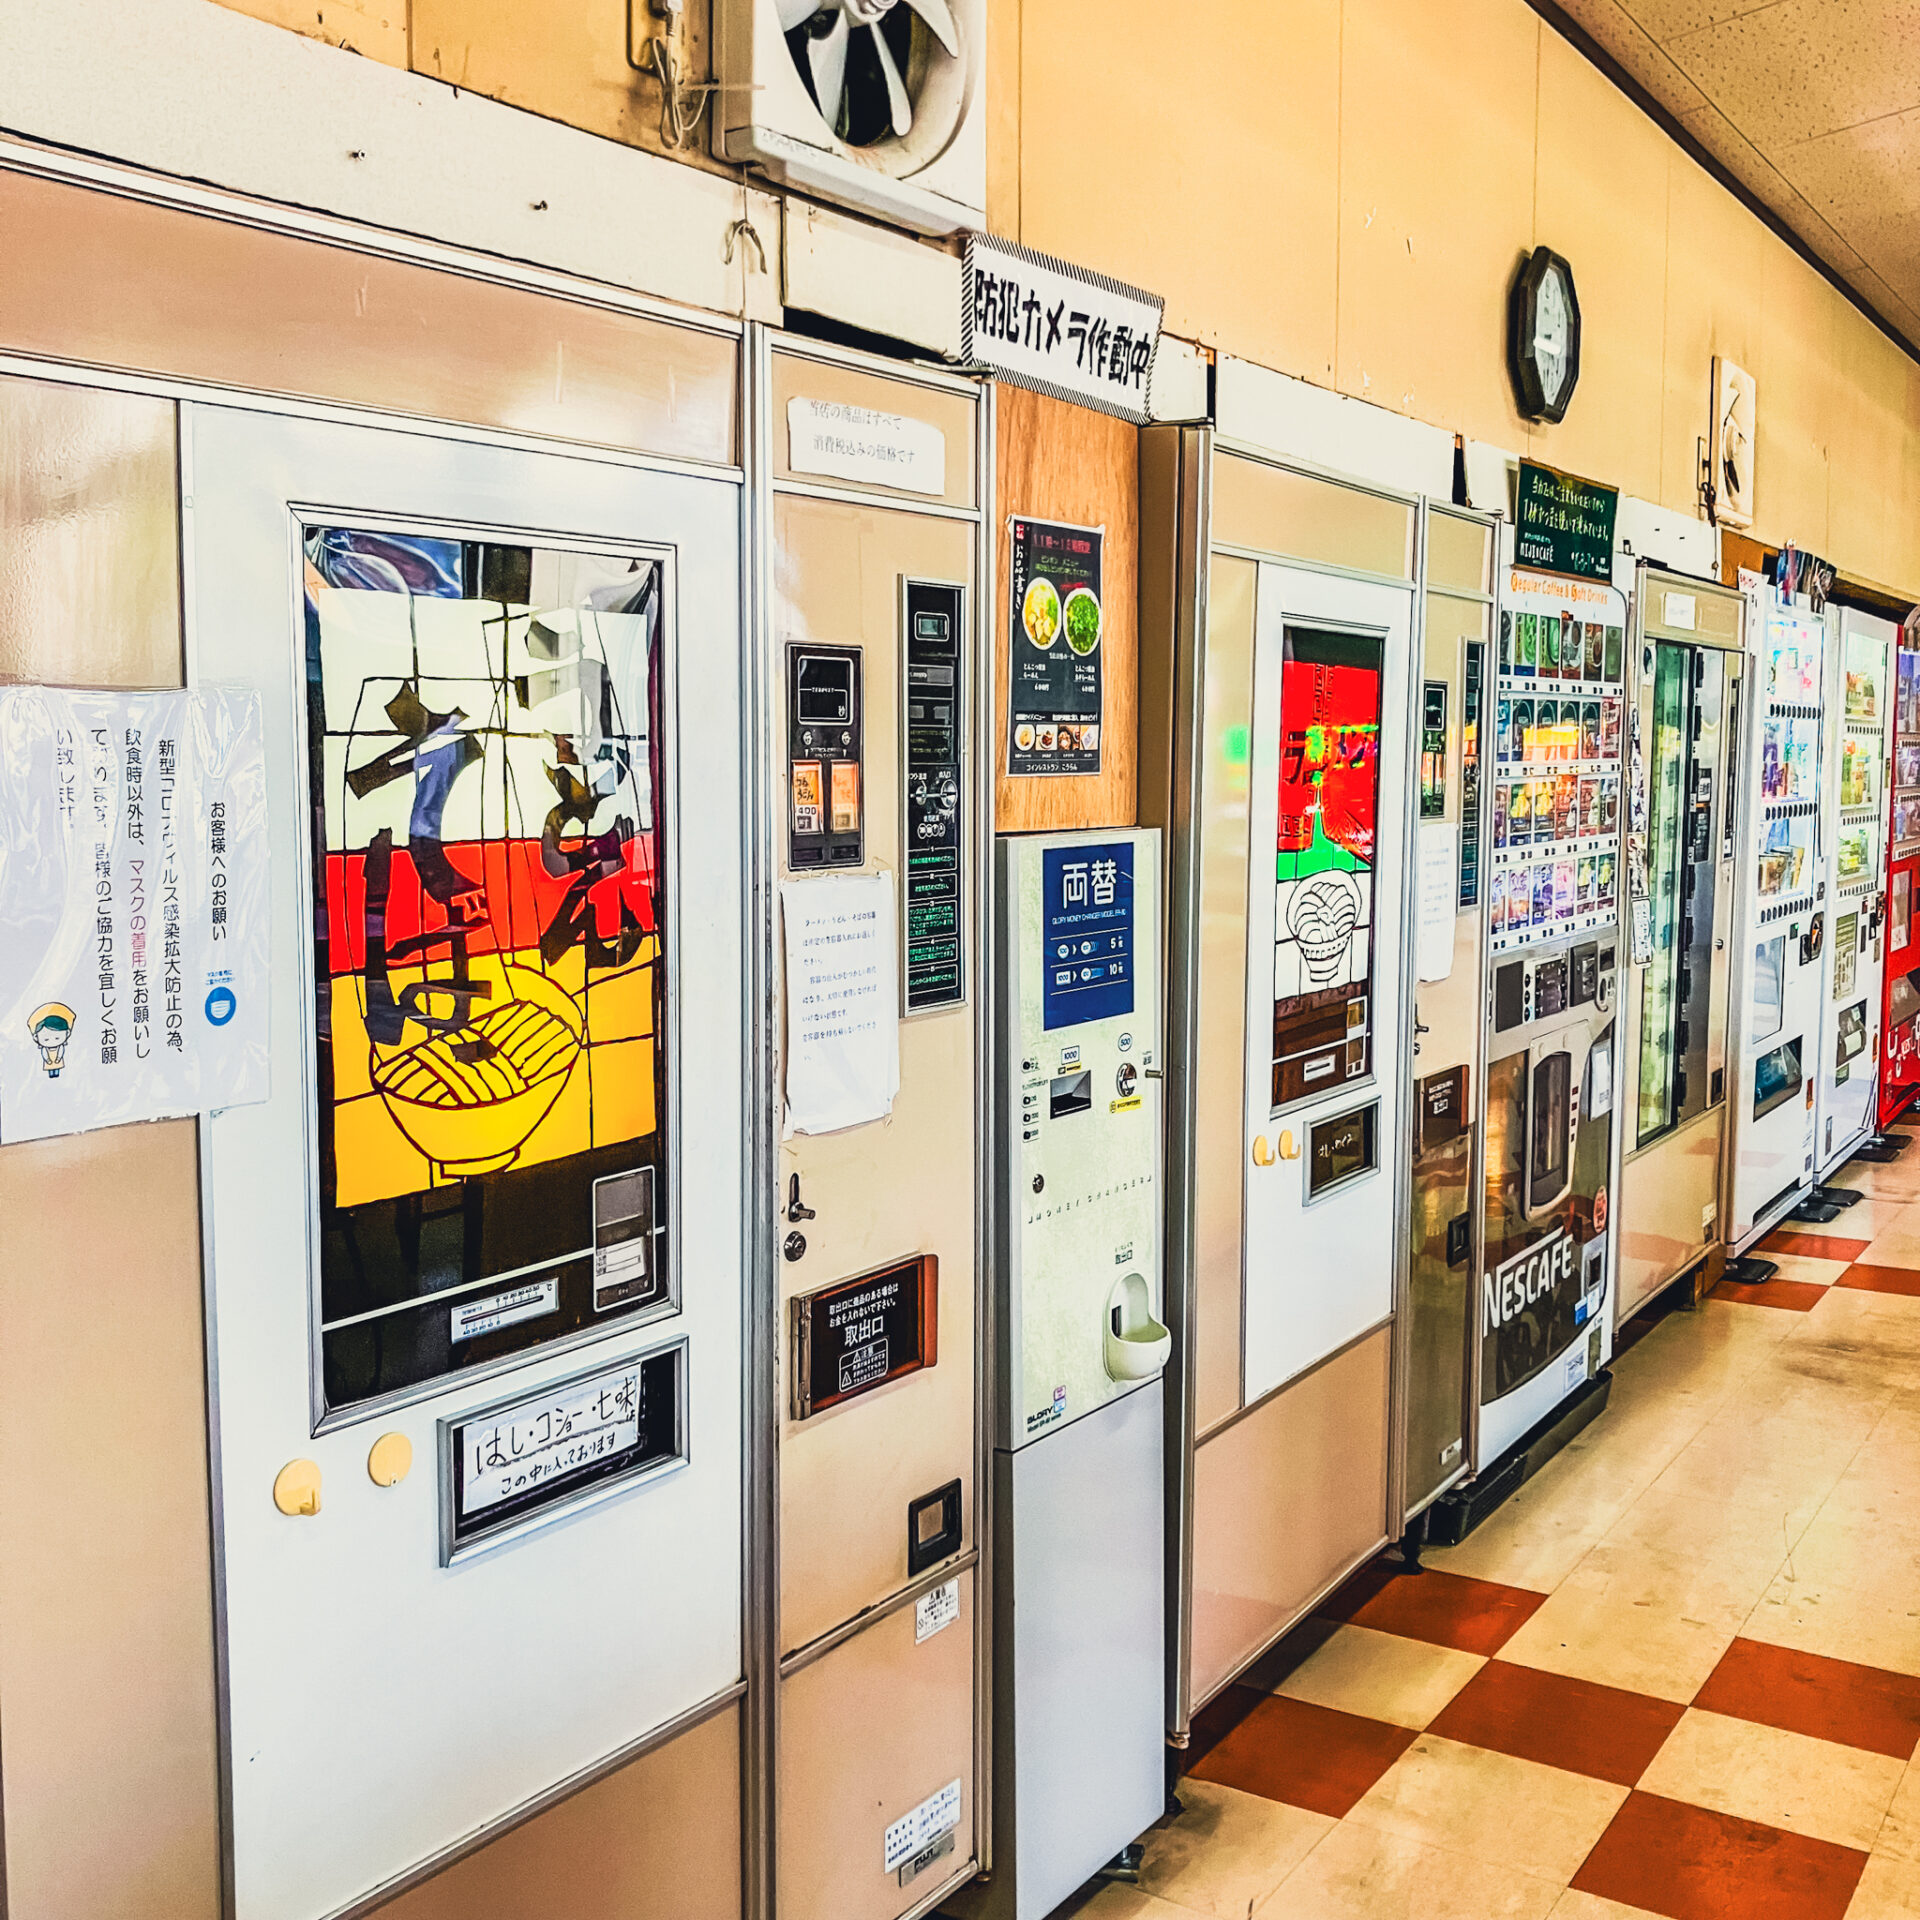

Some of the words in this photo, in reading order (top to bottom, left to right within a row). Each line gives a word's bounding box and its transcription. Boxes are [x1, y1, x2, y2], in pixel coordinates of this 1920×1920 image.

[973, 267, 1151, 389] 防犯カメラ作動中
[810, 400, 902, 430] 当店の商品はすべて
[813, 435, 915, 463] 消費税込みの価格です
[1511, 572, 1540, 592] Regular
[1542, 580, 1564, 597] Coffee
[1571, 585, 1586, 602] Soft
[1587, 589, 1608, 605] Drinks
[57, 729, 75, 829] い致します。
[211, 801, 227, 941] お客様へのお願い
[1062, 859, 1117, 909] 両替
[1064, 1050, 1077, 1060] 1000
[1120, 1038, 1131, 1047] 500
[829, 1283, 899, 1315] 取出口に商品のある場合は
[829, 1299, 896, 1328] お金を入れないで下さい。
[844, 1315, 884, 1346] 取出口
[501, 1432, 616, 1494] この中に入っております
